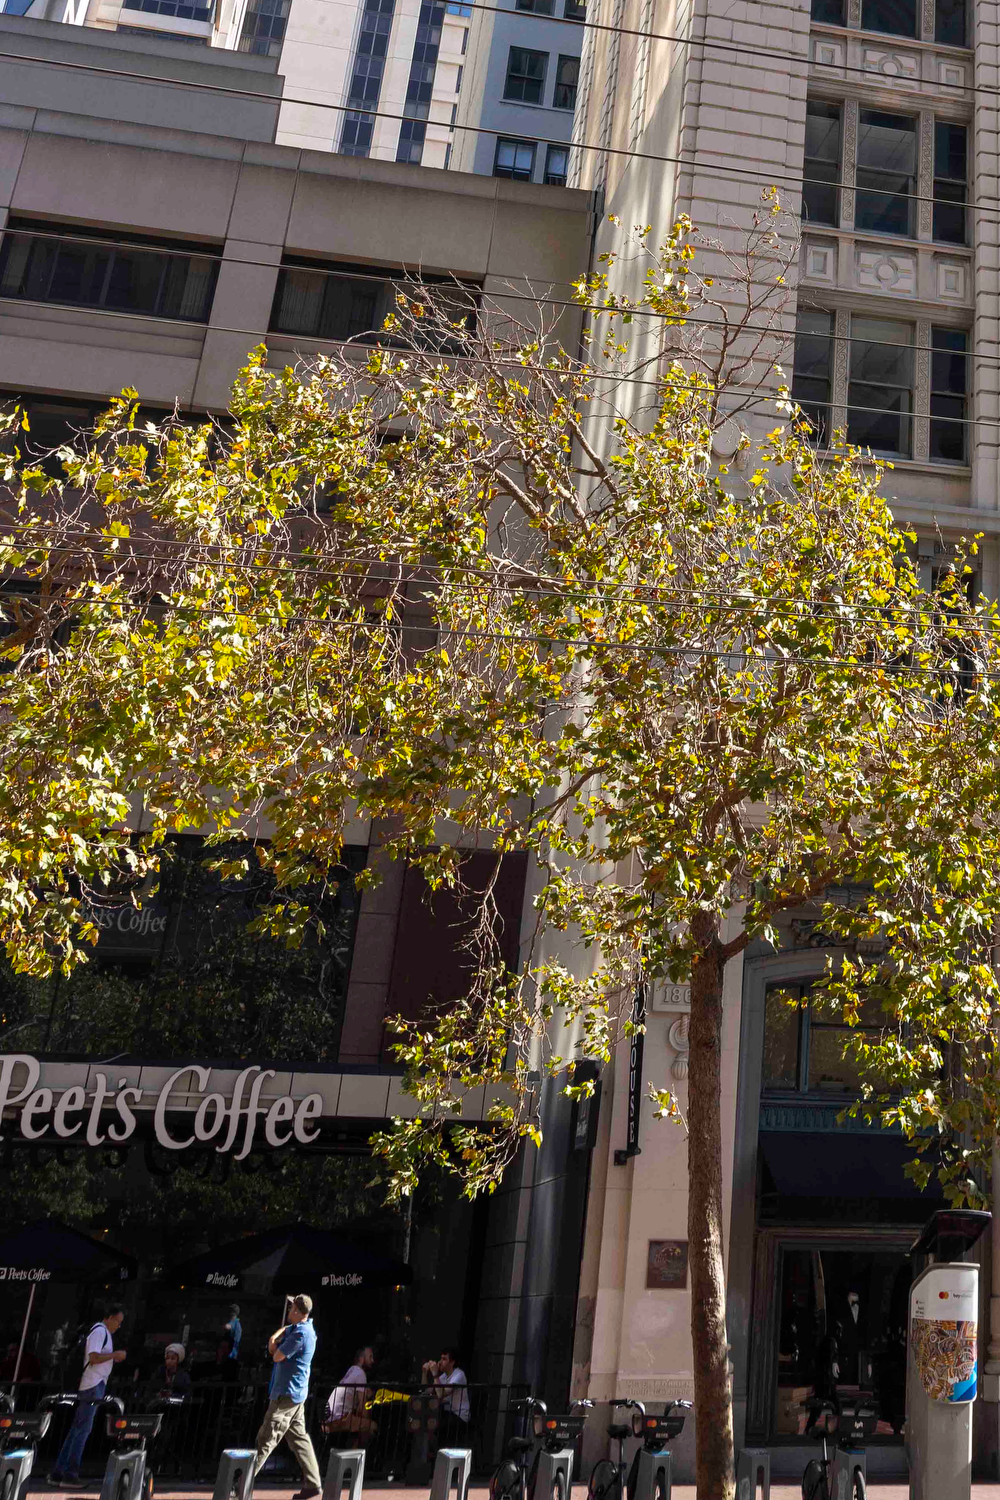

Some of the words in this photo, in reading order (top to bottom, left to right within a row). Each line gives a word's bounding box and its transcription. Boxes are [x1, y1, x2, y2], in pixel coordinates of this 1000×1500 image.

[663, 986, 691, 1003] 186
[0, 1054, 143, 1146] Peet's
[154, 1065, 323, 1160] Coffee
